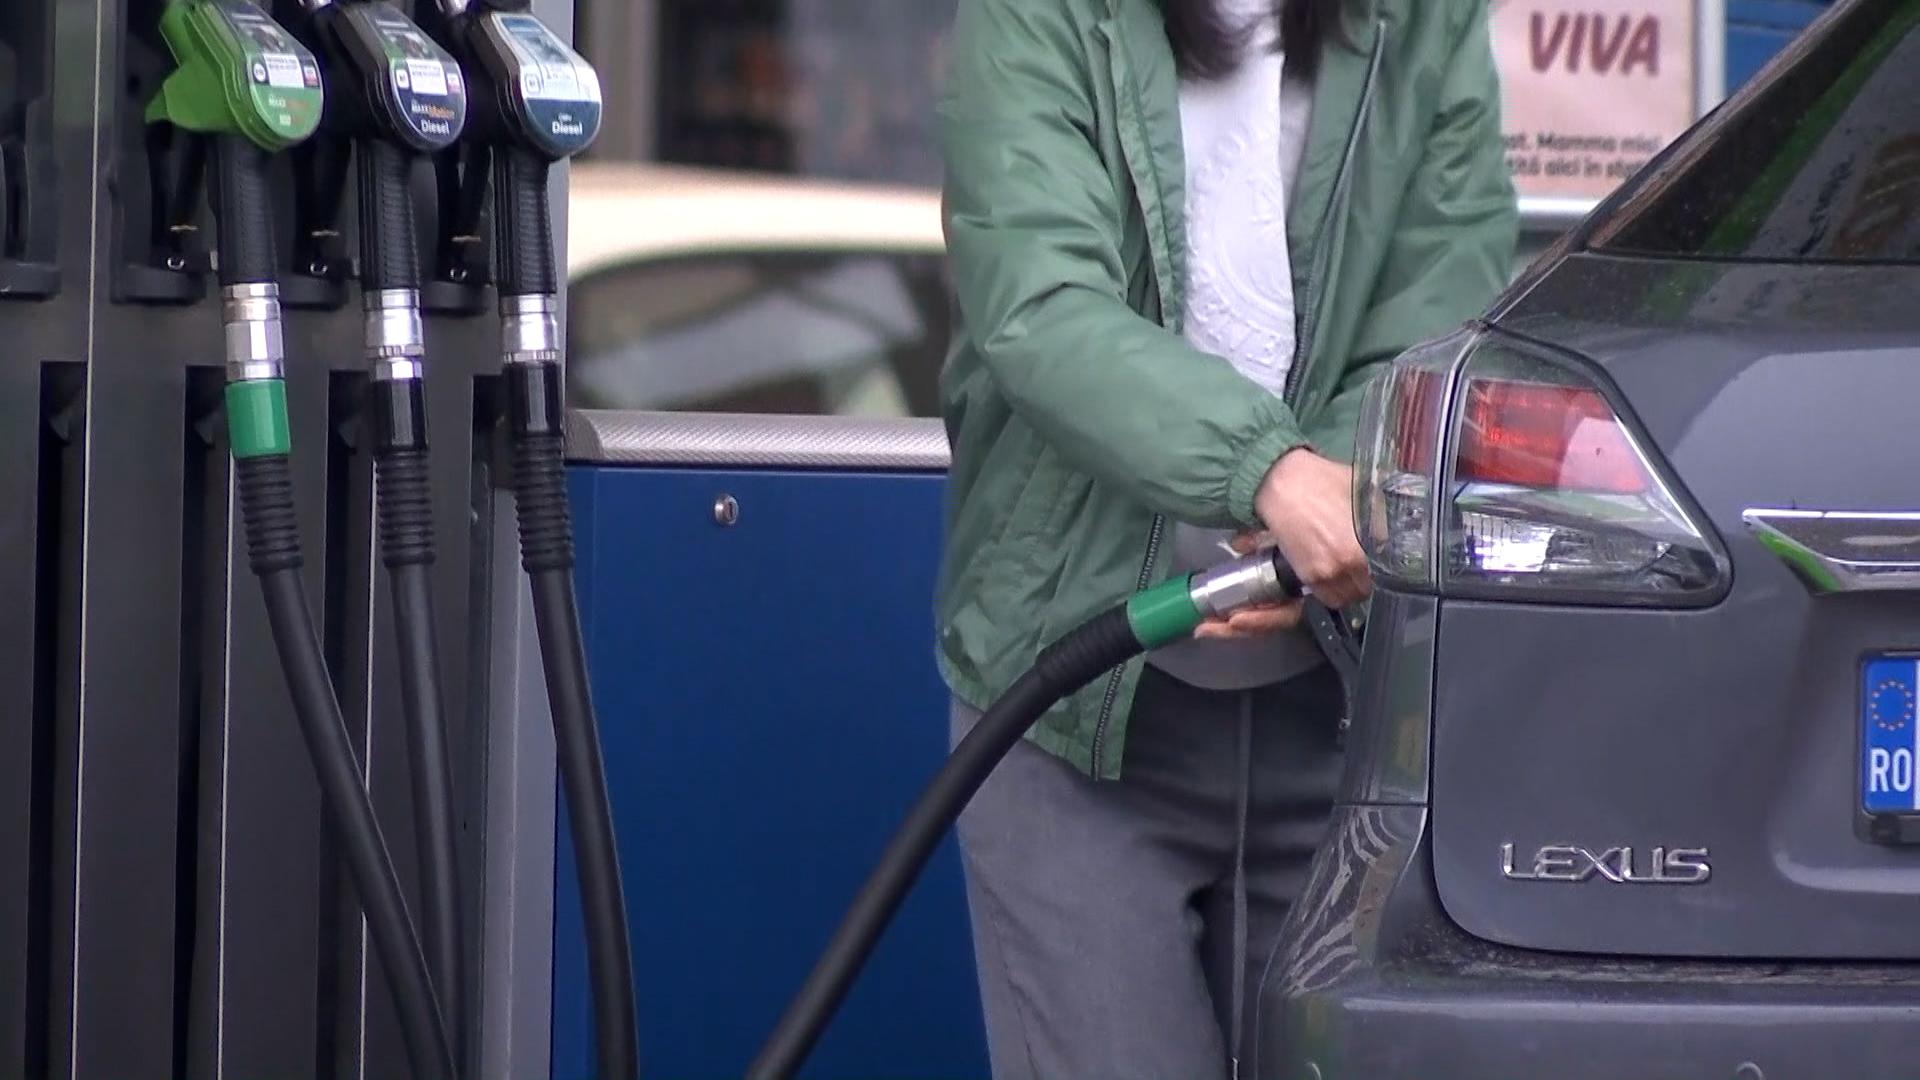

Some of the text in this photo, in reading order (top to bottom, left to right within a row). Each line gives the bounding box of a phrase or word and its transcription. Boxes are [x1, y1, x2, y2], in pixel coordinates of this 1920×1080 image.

[1529, 12, 1660, 76] VIVA
[421, 119, 449, 134] Diesel
[552, 121, 583, 135] Diesel
[1536, 133, 1617, 151] Mamma
[1869, 747, 1912, 793] RO
[1502, 843, 1712, 884] LEXUS
